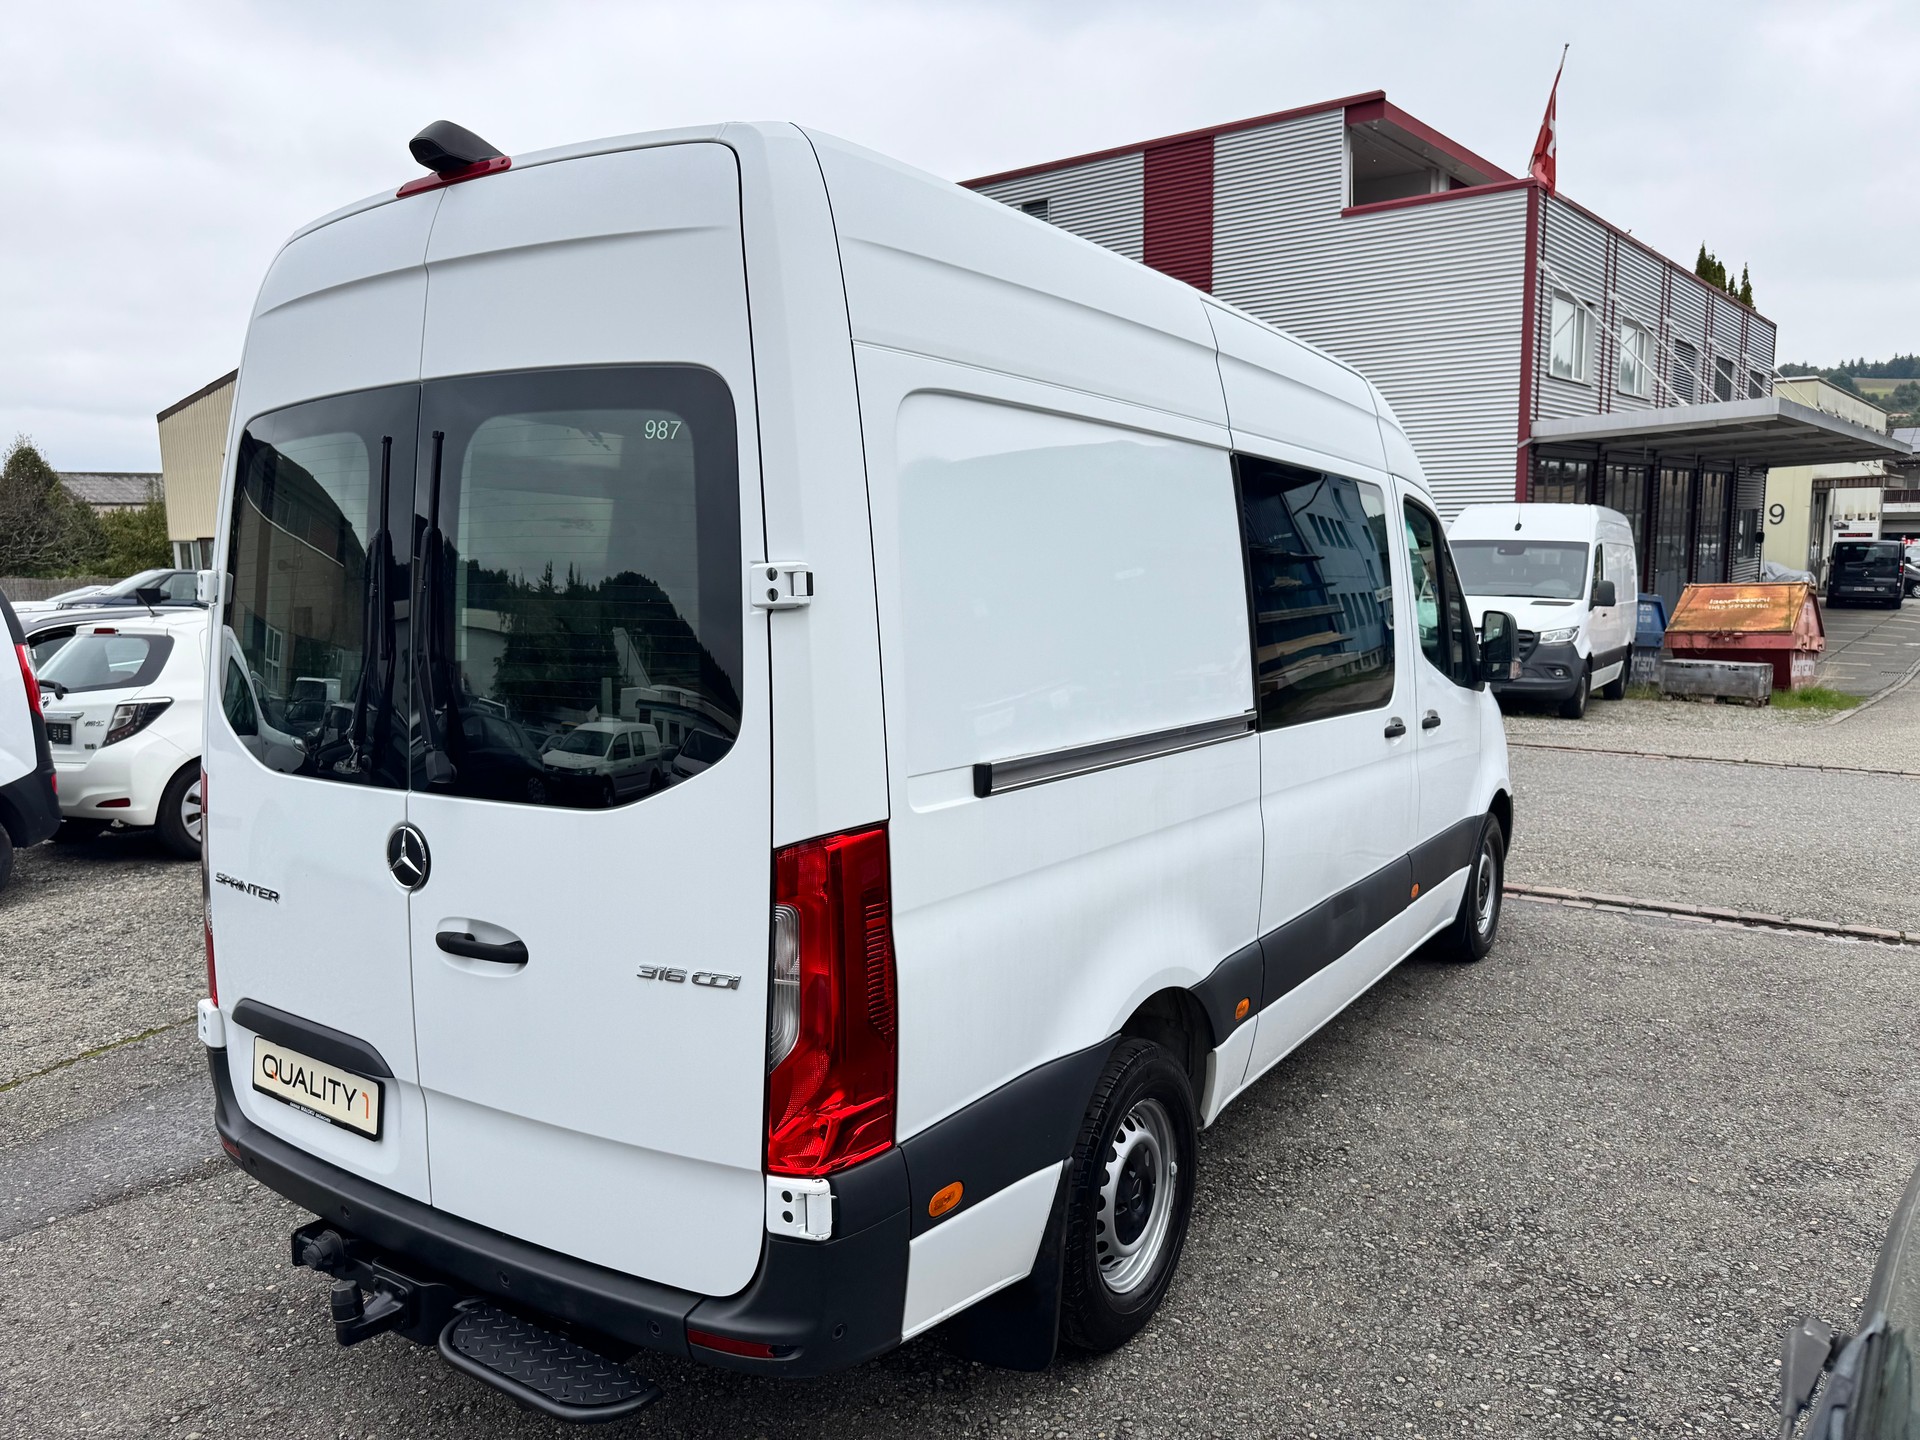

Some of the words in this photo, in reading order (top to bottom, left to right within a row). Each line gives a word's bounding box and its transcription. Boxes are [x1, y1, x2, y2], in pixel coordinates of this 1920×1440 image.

[644, 419, 682, 440] 987
[1768, 503, 1785, 525] 9
[215, 872, 280, 904] SPRINTER
[636, 962, 688, 984] 316
[691, 970, 742, 991] CDI
